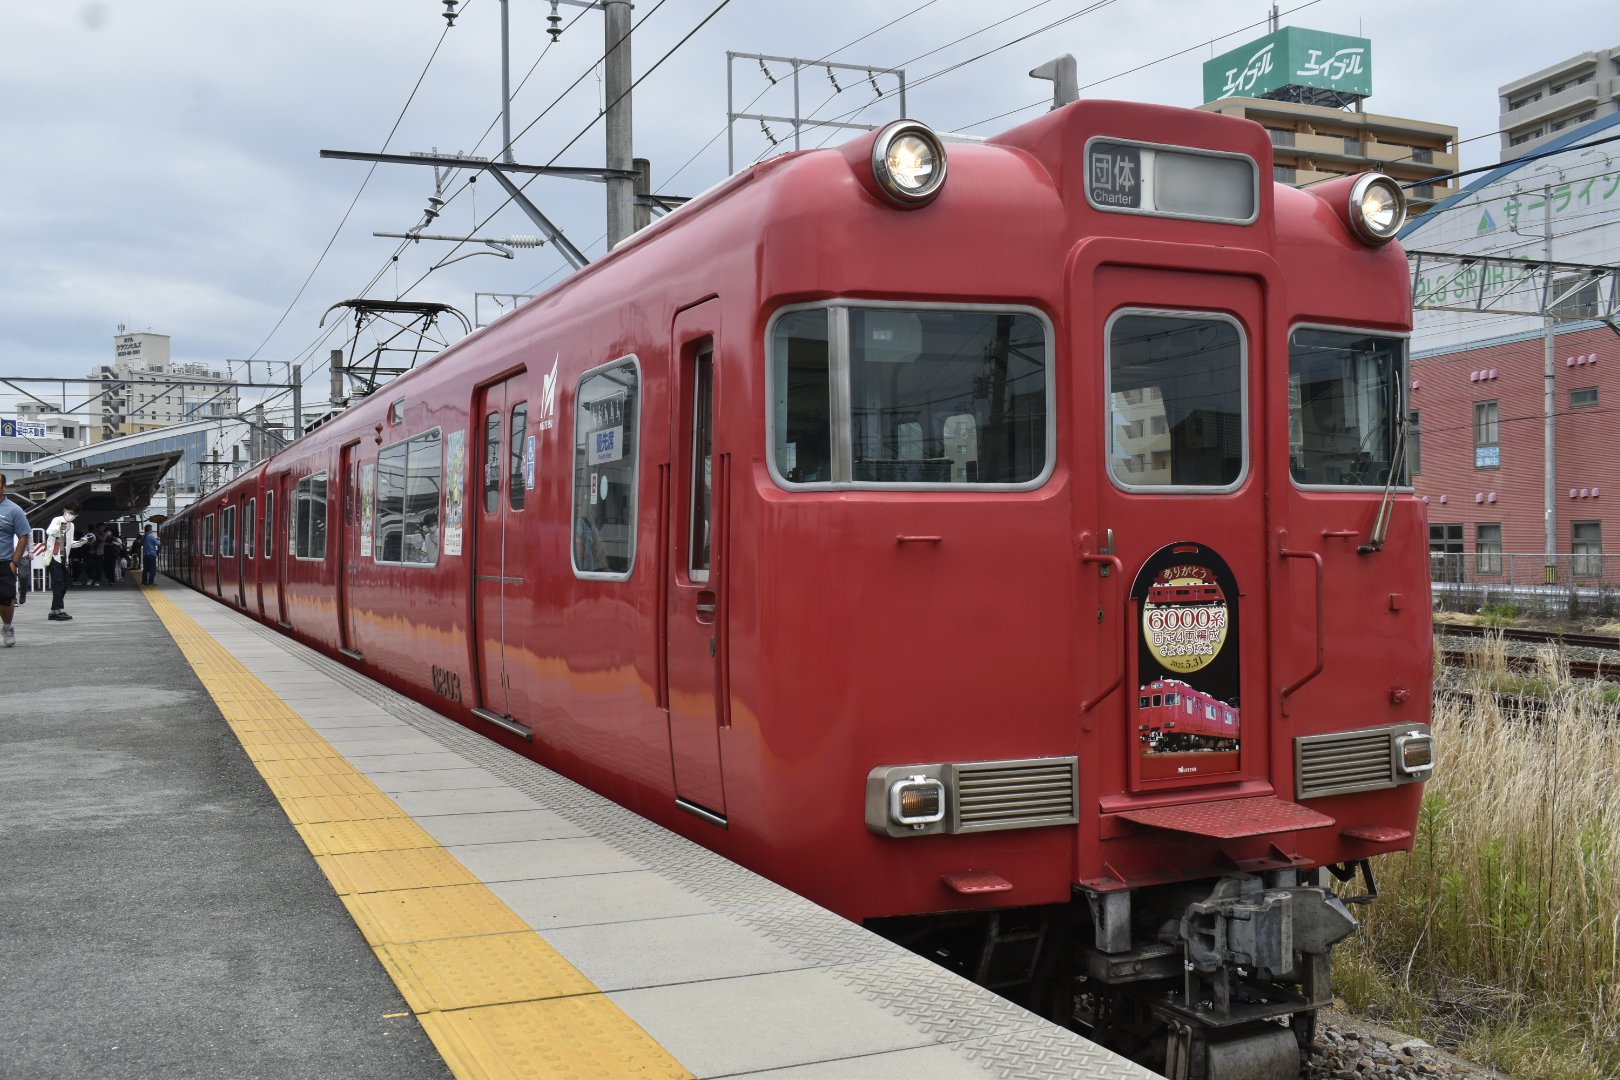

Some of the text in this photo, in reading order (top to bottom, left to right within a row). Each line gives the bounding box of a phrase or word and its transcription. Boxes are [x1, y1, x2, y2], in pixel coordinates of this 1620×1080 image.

[1217, 42, 1274, 100] エイブル
[1296, 48, 1364, 80] エイブル
[1092, 153, 1135, 192] 団体
[1093, 189, 1133, 205] Charter
[1163, 566, 1207, 579] ありがとう
[1148, 607, 1224, 631] 6000系
[1153, 628, 1220, 646] 固定4両編成
[1159, 642, 1213, 657] さよなら記念
[1170, 655, 1204, 669] 2025.5.31
